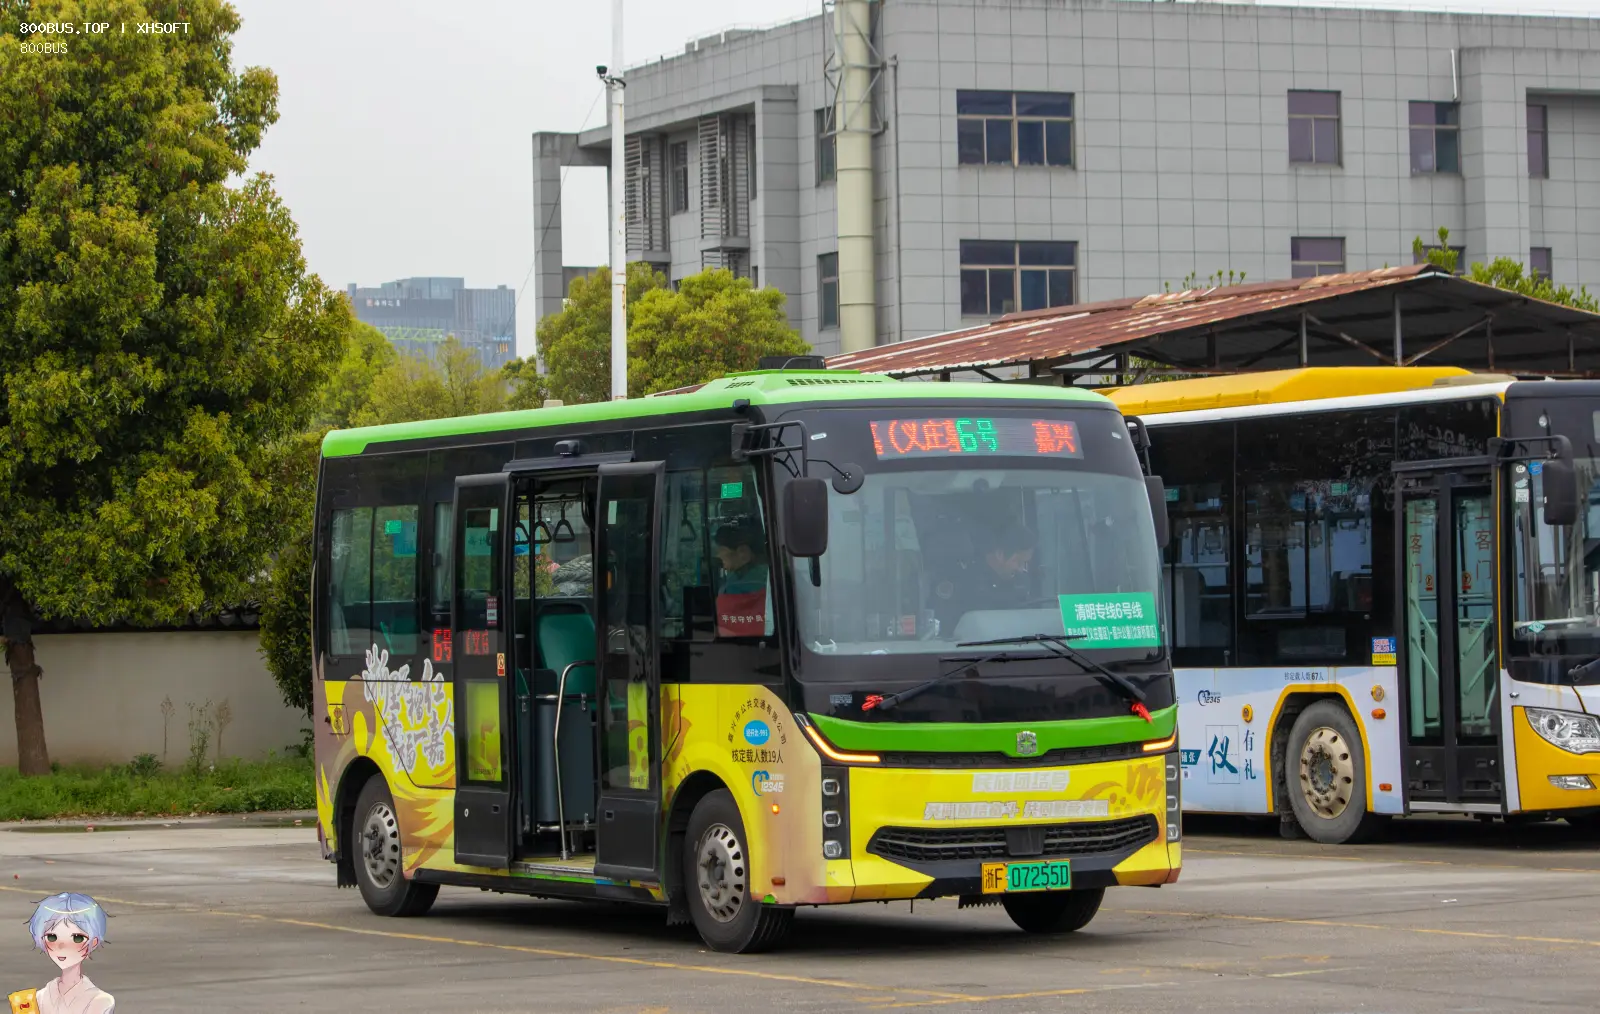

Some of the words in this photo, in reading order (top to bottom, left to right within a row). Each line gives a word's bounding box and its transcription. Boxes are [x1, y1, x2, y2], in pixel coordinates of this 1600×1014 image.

[955, 418, 998, 452] 6号
[1074, 601, 1144, 621] 清明专线6号线
[432, 628, 453, 662] 6号
[731, 748, 784, 764] 核定载人数19人
[761, 781, 785, 793] 12345
[1012, 864, 1069, 888] 07255D
